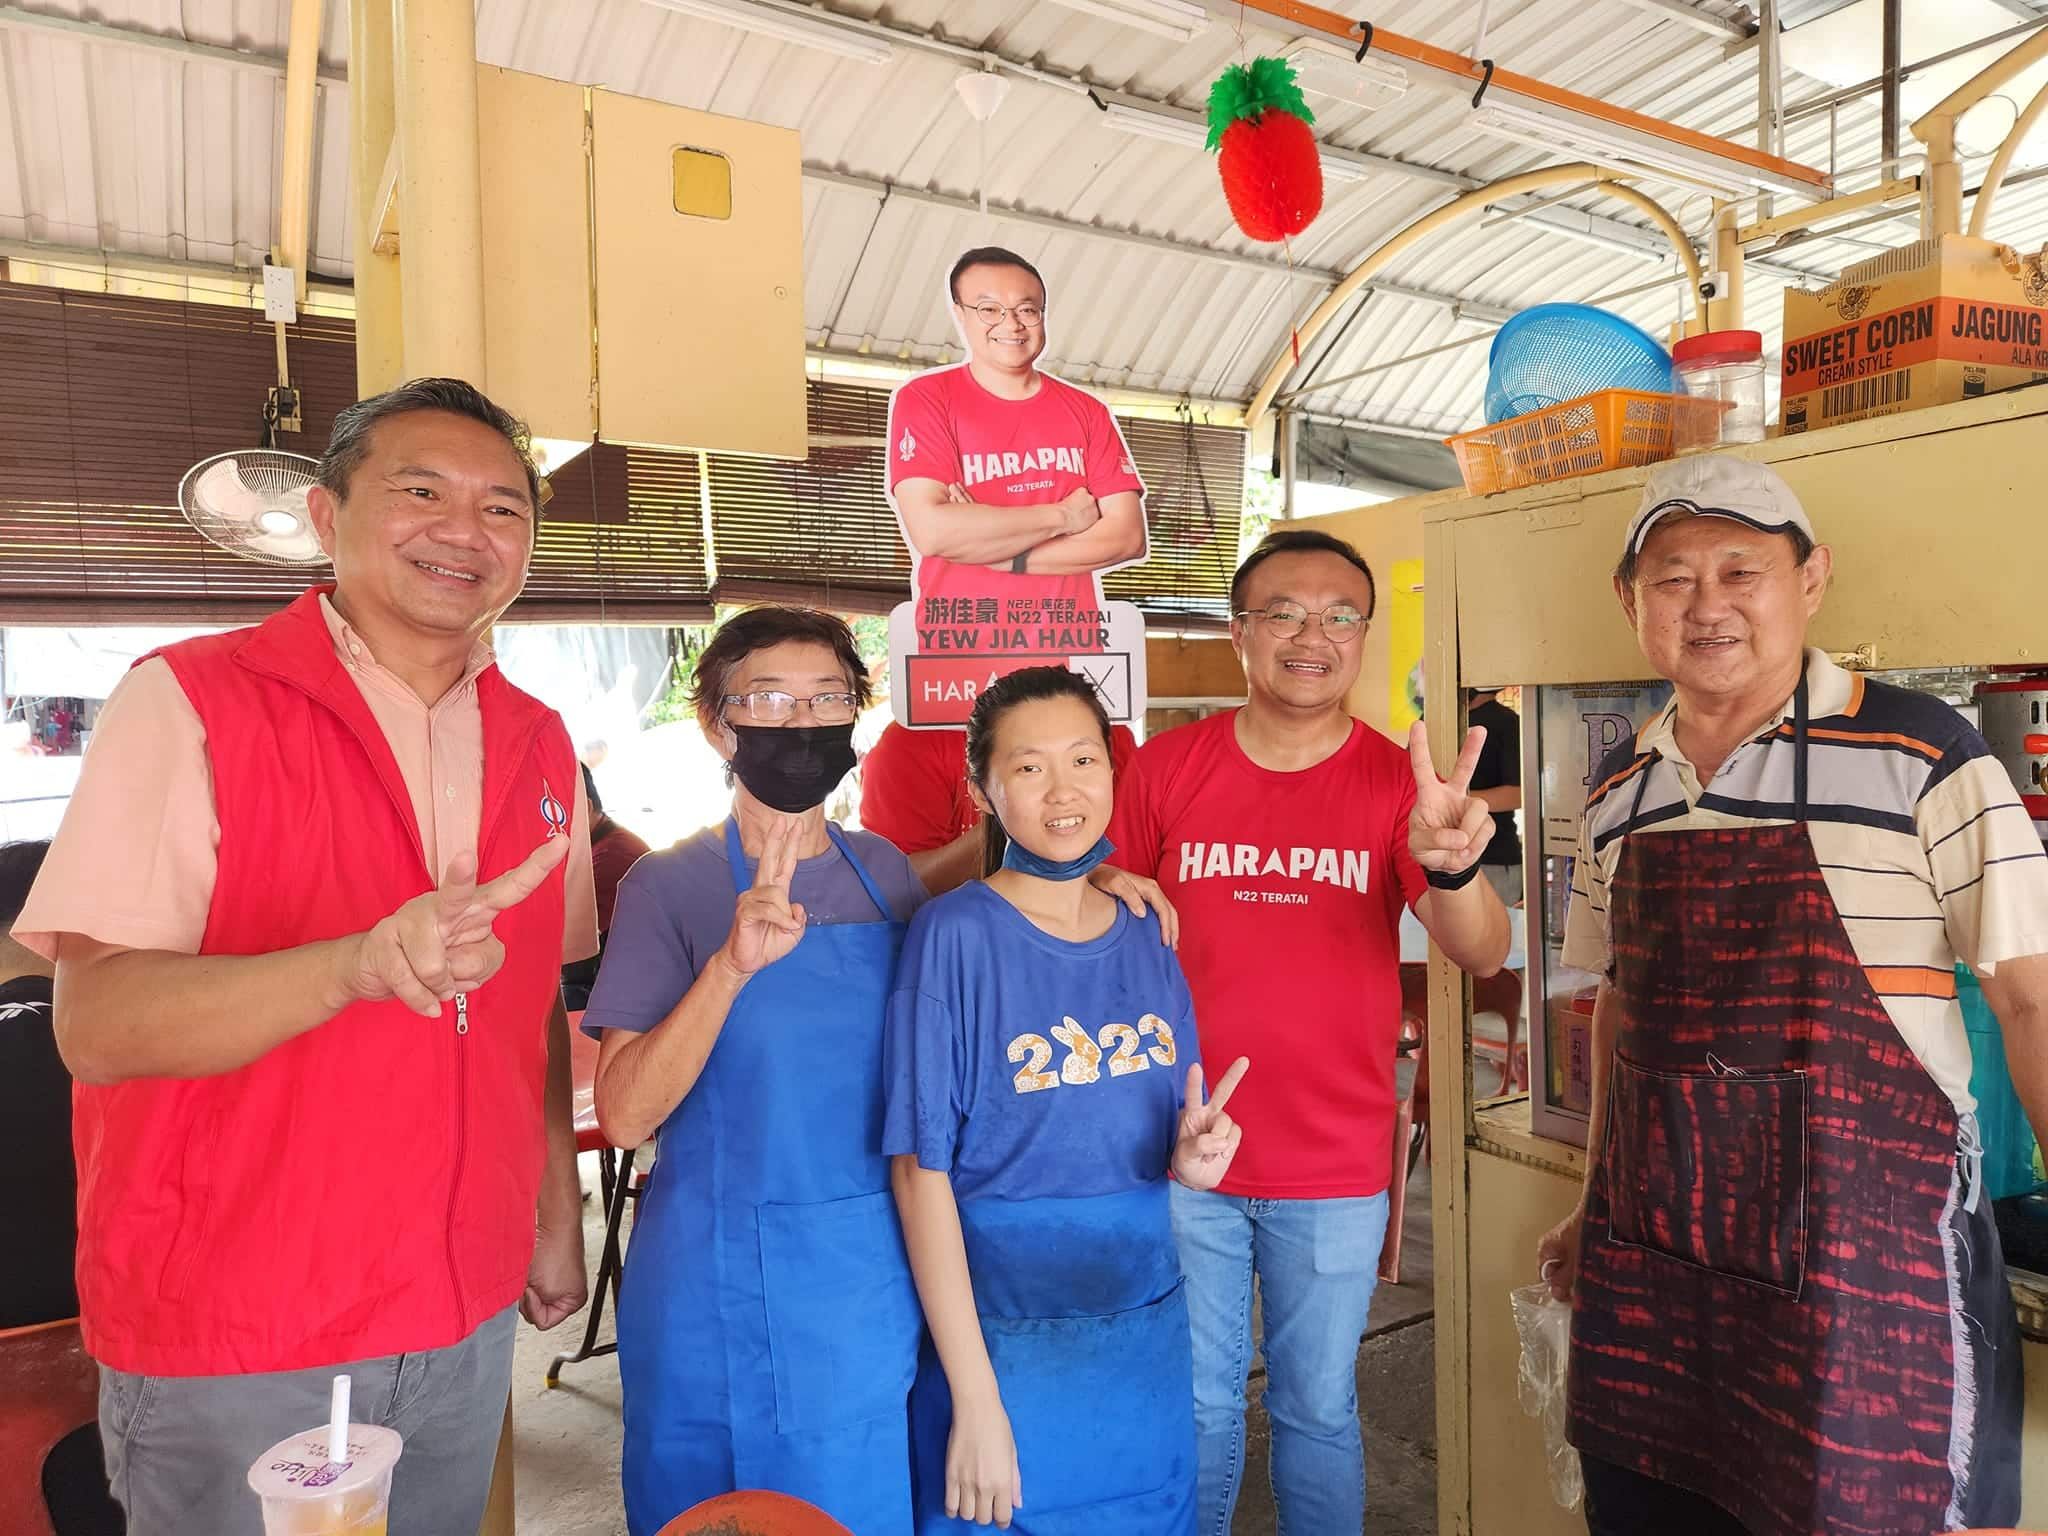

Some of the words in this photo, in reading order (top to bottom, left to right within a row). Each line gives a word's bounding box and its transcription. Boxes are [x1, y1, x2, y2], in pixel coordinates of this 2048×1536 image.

[1952, 304, 2041, 346] JAGUNG
[1785, 326, 1859, 376] SWEET
[1867, 304, 1934, 353] CORN
[2012, 346, 2031, 365] ALA
[1818, 363, 1855, 386] CREAM
[1859, 351, 1892, 376] STYLE
[963, 447, 1085, 486] HARAPAN
[1007, 484, 1023, 493] N22
[925, 598, 998, 624] 游佳豪
[1007, 600, 1032, 609] N22
[1008, 611, 1041, 624] N22
[1047, 610, 1111, 623] TERATAI
[919, 629, 979, 649] YEW
[989, 628, 1028, 649] JIA
[1039, 628, 1110, 649] HAUR
[1179, 842, 1369, 894] HARAPAN
[1233, 890, 1257, 902] N22
[1261, 892, 1308, 904] TERATAI
